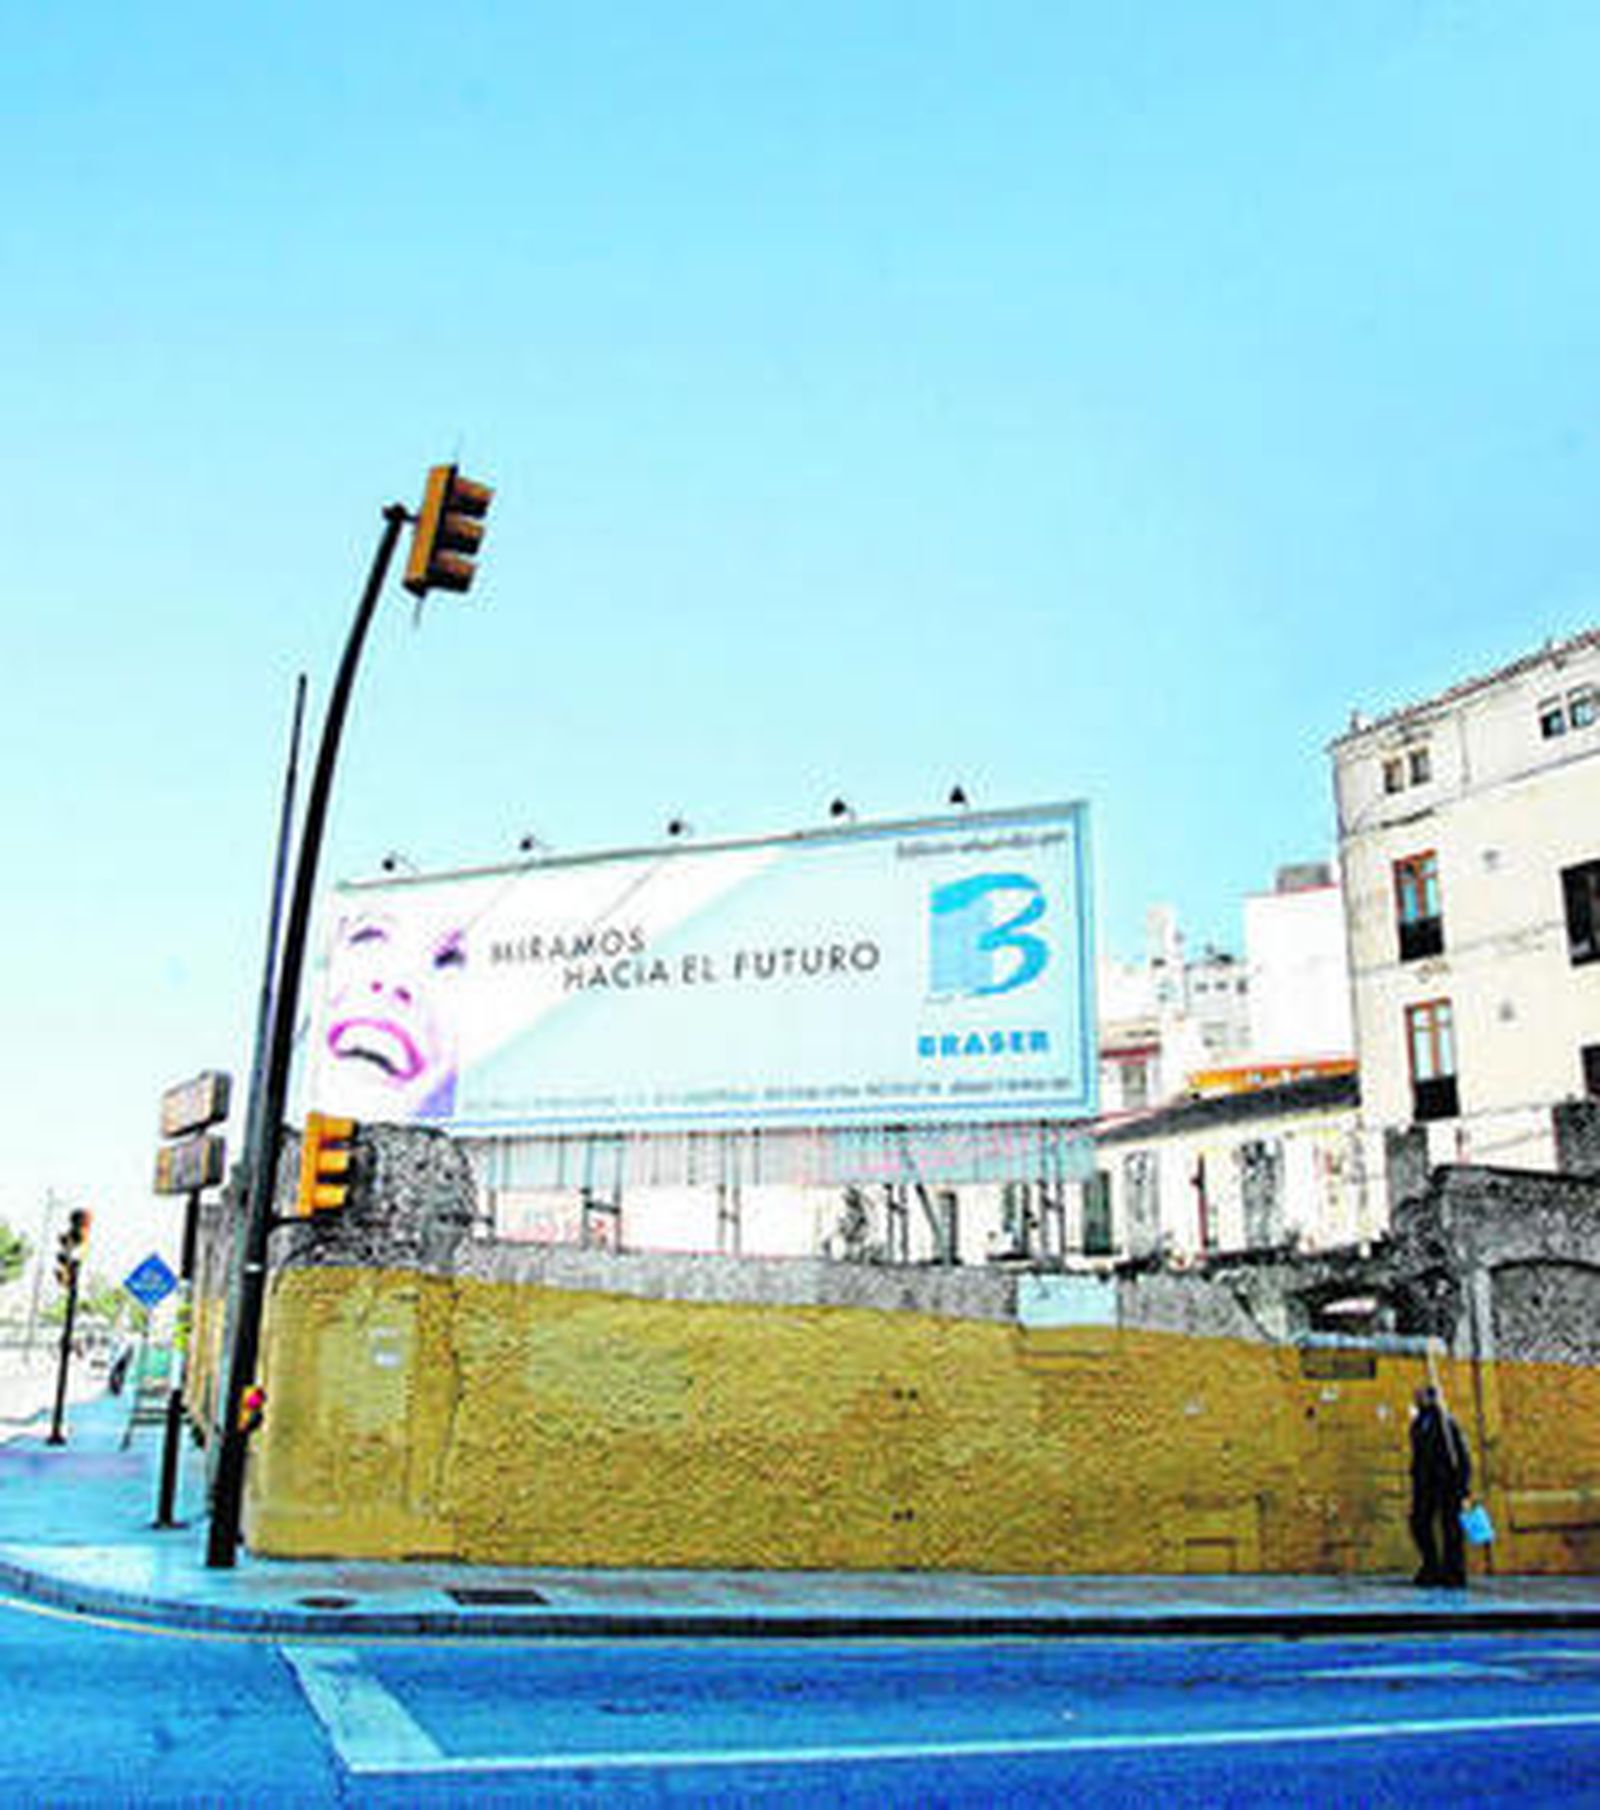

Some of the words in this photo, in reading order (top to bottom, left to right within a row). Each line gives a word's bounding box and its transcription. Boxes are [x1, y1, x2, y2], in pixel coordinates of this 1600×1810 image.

[490, 926, 646, 964] MIRAMOS
[562, 957, 670, 991] HACIA
[681, 953, 718, 985] EL
[733, 940, 881, 981] FUTURO
